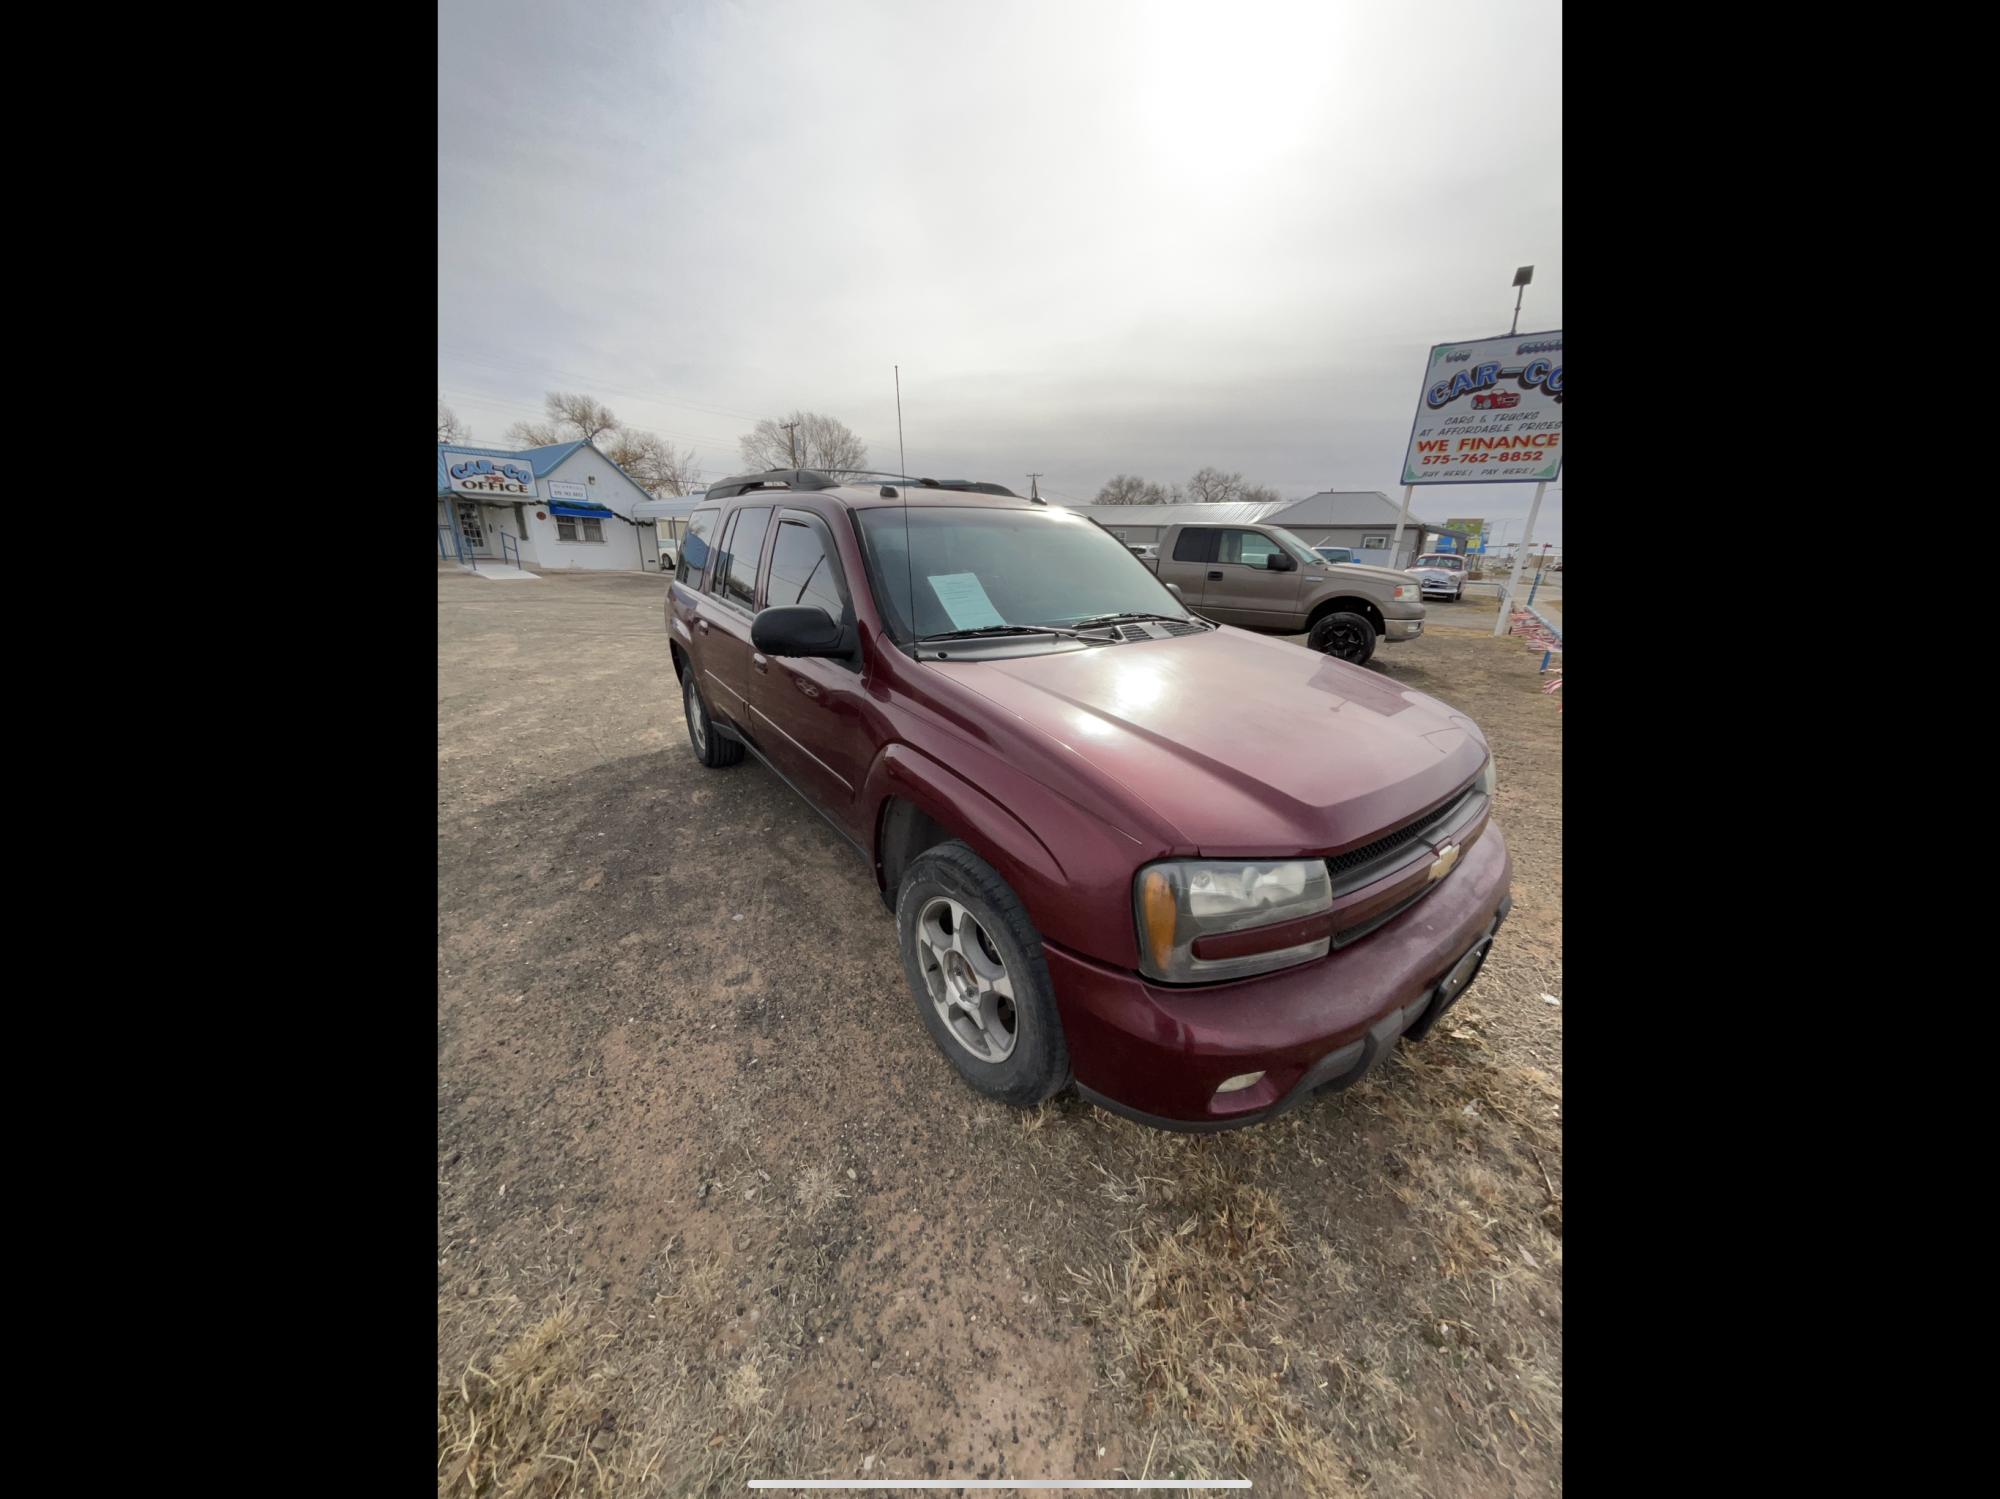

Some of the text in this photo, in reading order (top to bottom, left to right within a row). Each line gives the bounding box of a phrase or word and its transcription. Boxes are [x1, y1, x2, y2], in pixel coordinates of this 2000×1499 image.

[1445, 416, 1474, 424] CARS
[1494, 411, 1540, 422] TRUCKS
[1418, 421, 1562, 437] AT AFFORDABLE PRICES
[1417, 433, 1560, 452] WE FINANCE
[1422, 451, 1543, 465] 575-762-8852
[450, 460, 531, 484] CAR-CO
[461, 480, 529, 493] OFFICE
